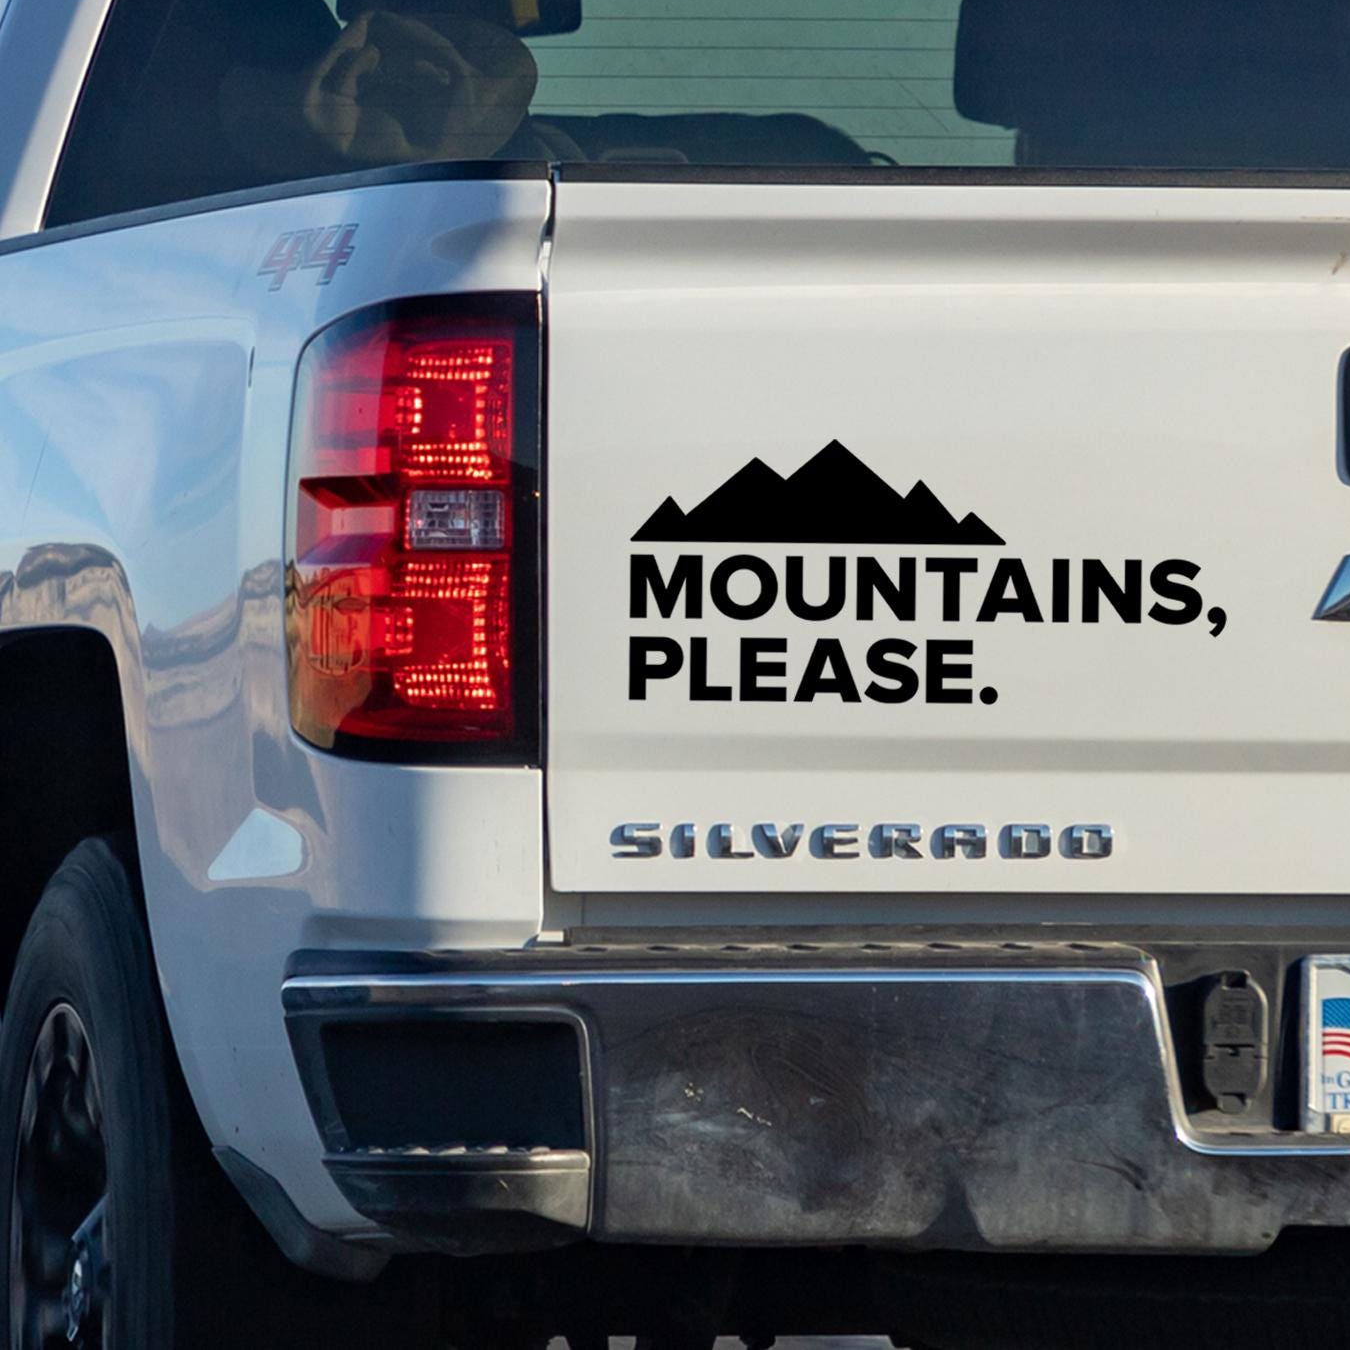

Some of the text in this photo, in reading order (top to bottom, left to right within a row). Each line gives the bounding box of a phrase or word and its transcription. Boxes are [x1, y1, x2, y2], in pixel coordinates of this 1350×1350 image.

[629, 553, 1227, 637] MOUNTAINS,
[628, 635, 998, 705] PLEASE.
[609, 822, 1113, 860] SILVERADO
